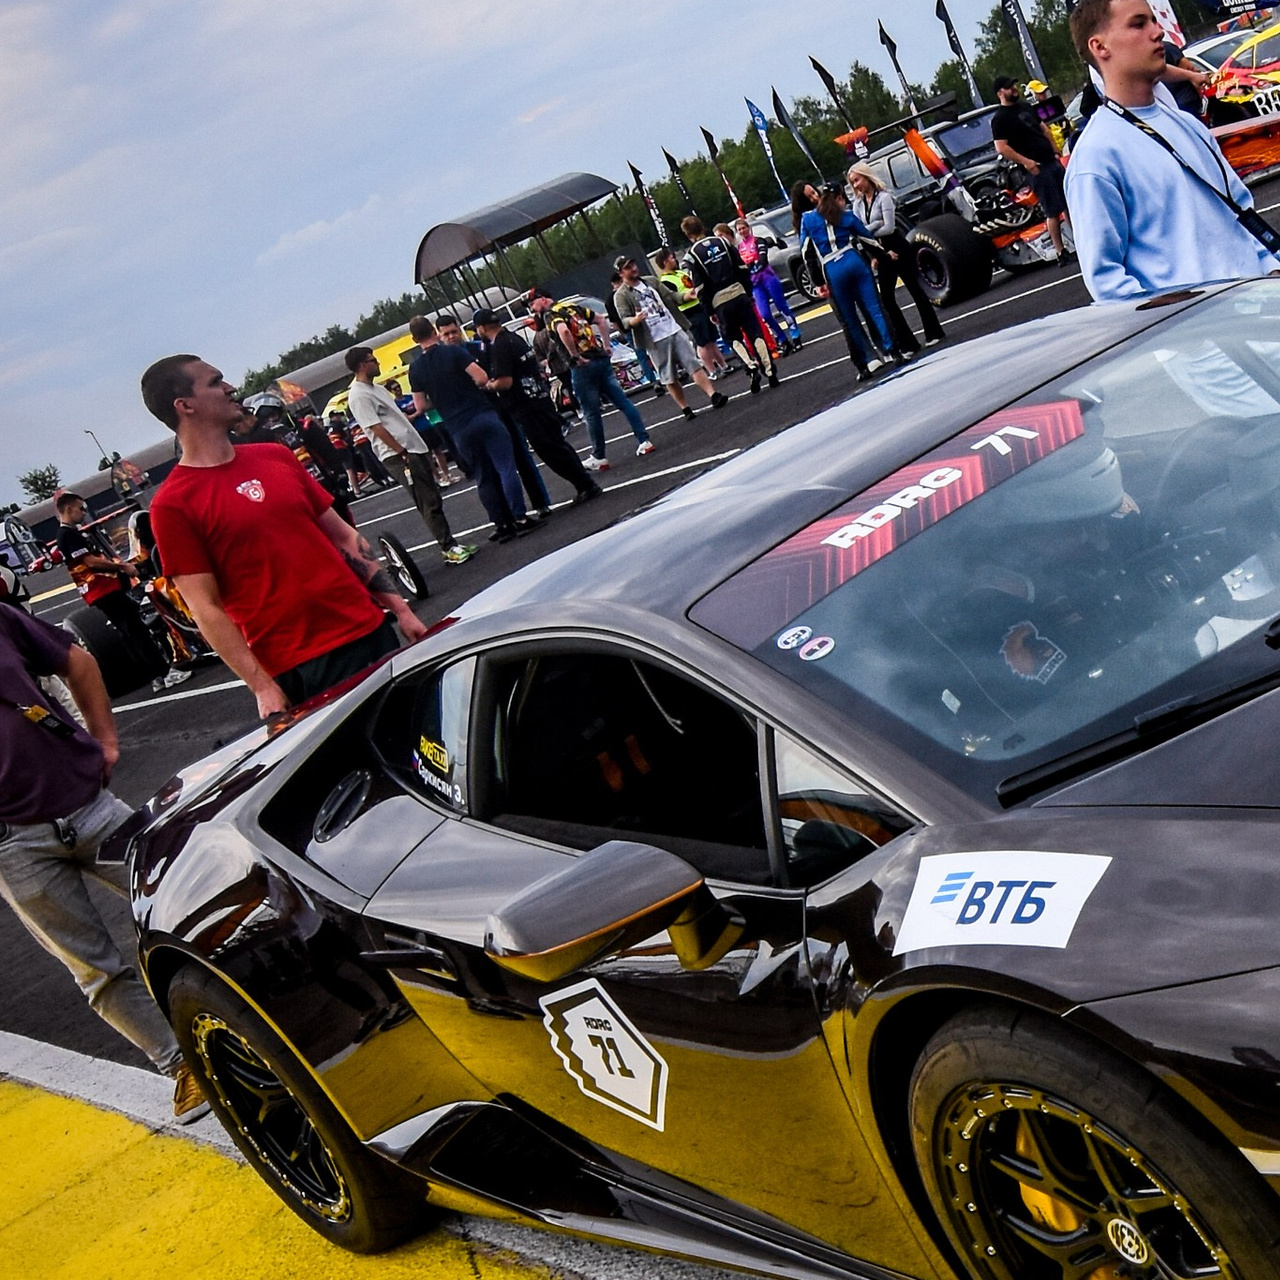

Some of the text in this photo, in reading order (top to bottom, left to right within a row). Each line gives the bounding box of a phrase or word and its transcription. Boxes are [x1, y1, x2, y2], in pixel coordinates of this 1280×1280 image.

[819, 467, 963, 549] RDRC
[454, 784, 465, 805] Э.
[955, 881, 1057, 925] ВТБ
[583, 1016, 613, 1032] RDRC
[588, 1034, 636, 1079] 71
